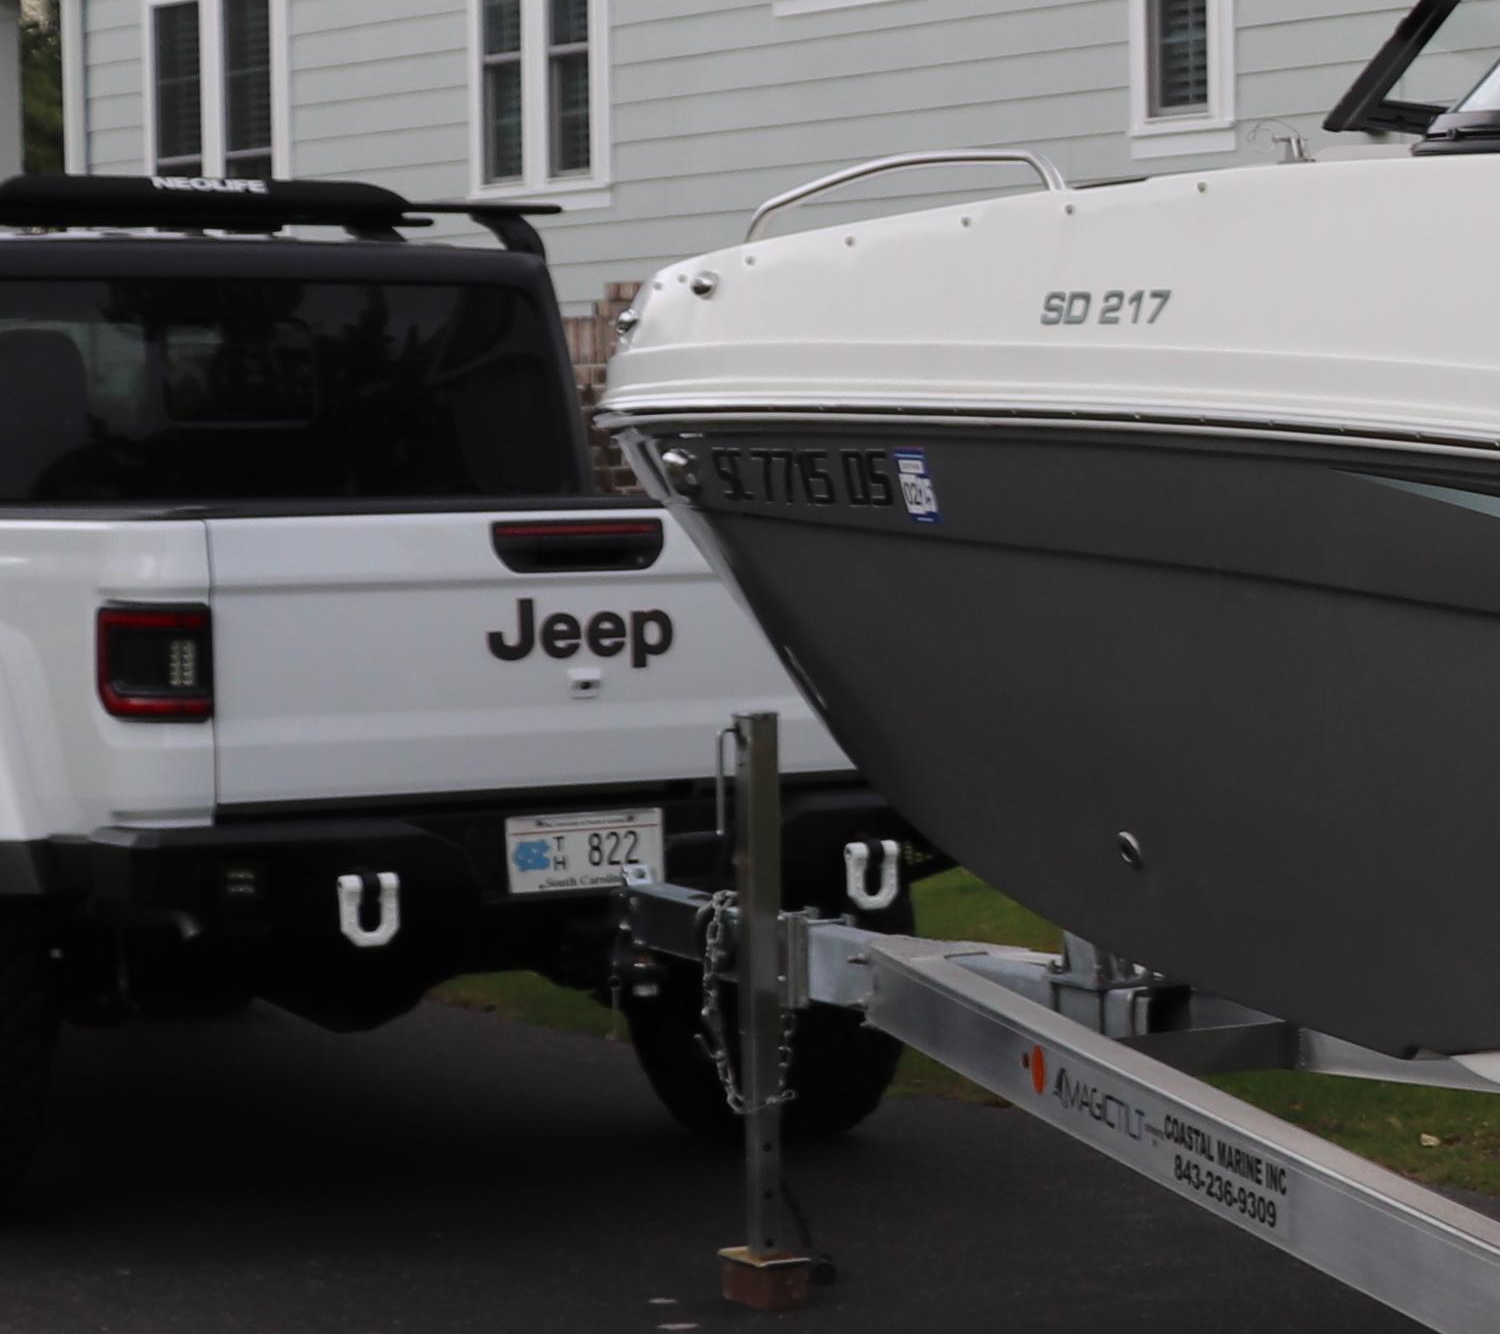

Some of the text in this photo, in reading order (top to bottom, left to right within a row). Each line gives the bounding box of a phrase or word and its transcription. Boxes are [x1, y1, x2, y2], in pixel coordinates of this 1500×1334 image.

[151, 176, 269, 194] NEOLIFE
[1040, 289, 1172, 326] SD 217
[486, 597, 674, 669] Jeep
[588, 829, 640, 867] 822
[544, 873, 624, 888] South Carolin
[1163, 1114, 1215, 1163] COASTAL
[1217, 1138, 1263, 1186] MARINE
[1265, 1160, 1288, 1196] INC
[1173, 1154, 1278, 1229] 843-236-9309
